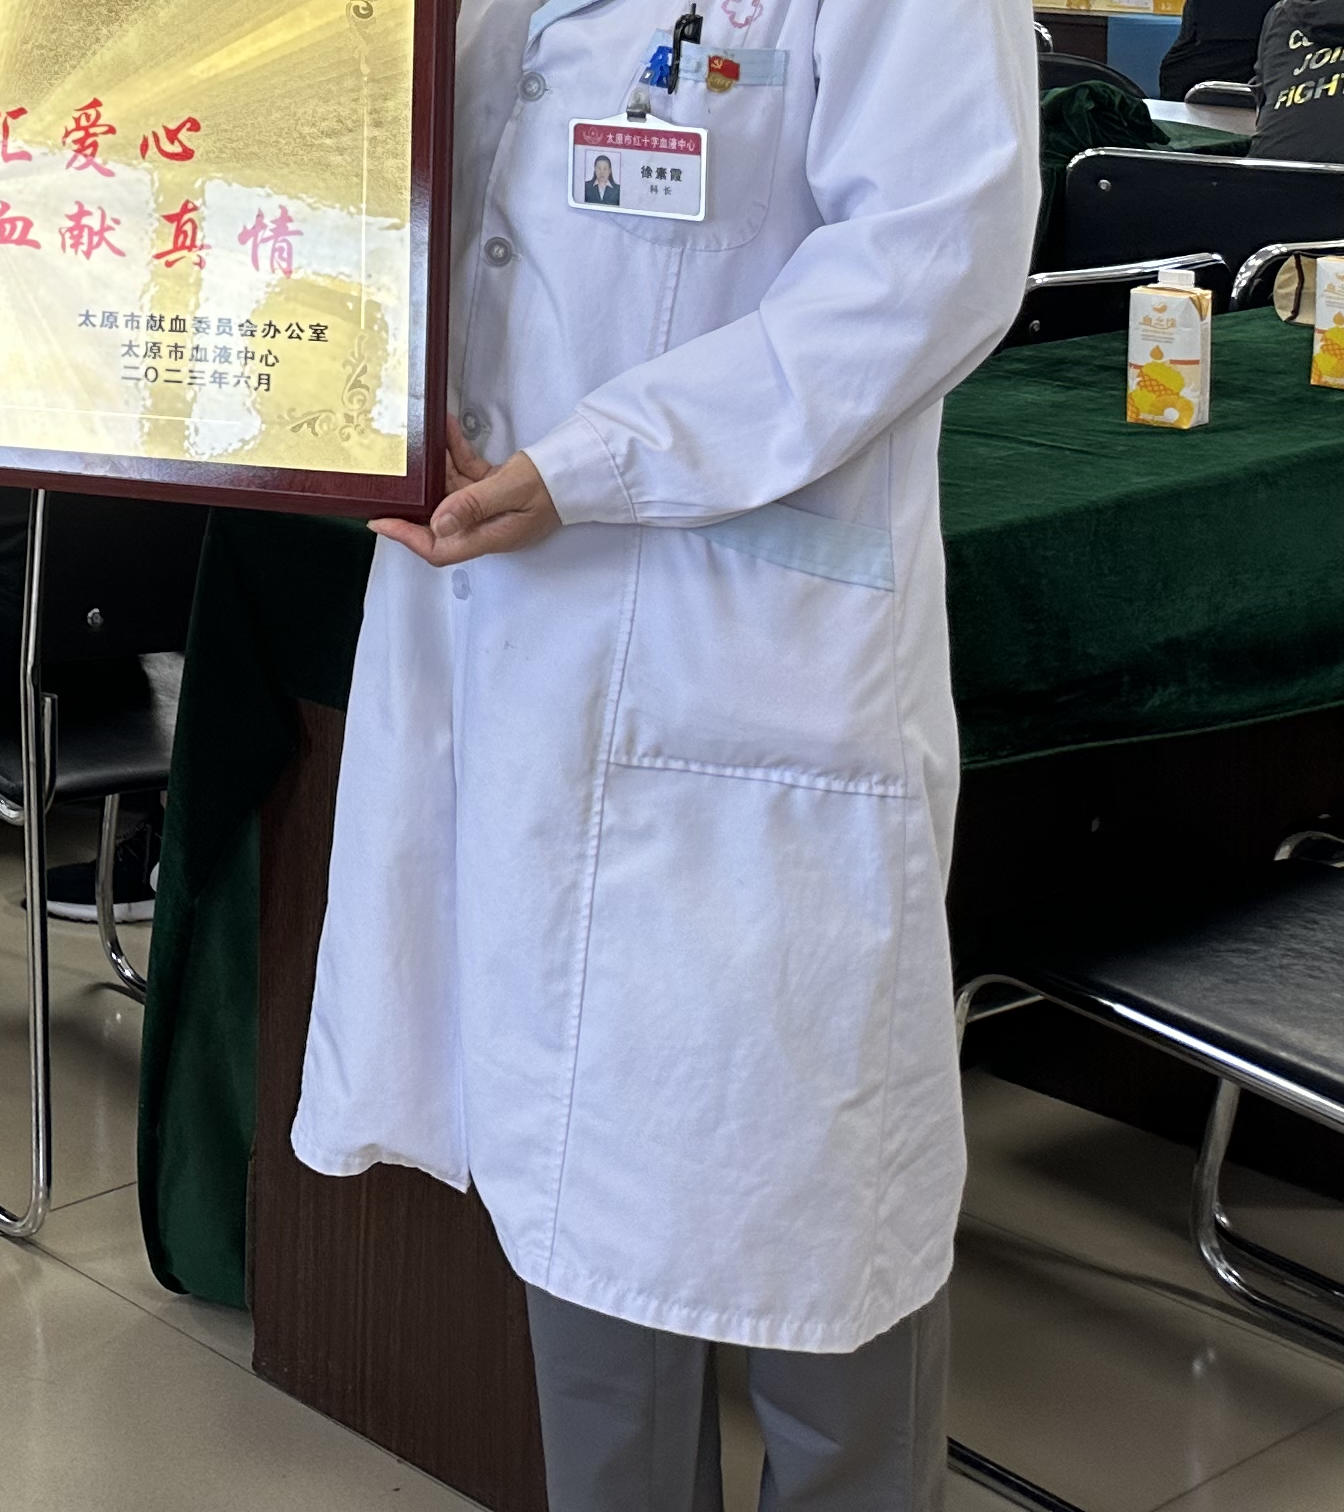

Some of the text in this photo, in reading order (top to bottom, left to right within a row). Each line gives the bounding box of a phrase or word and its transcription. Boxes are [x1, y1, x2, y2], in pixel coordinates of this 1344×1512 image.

[77, 309, 329, 343] 太原市献血委员会办公室
[120, 340, 280, 368] 太原市血液中心
